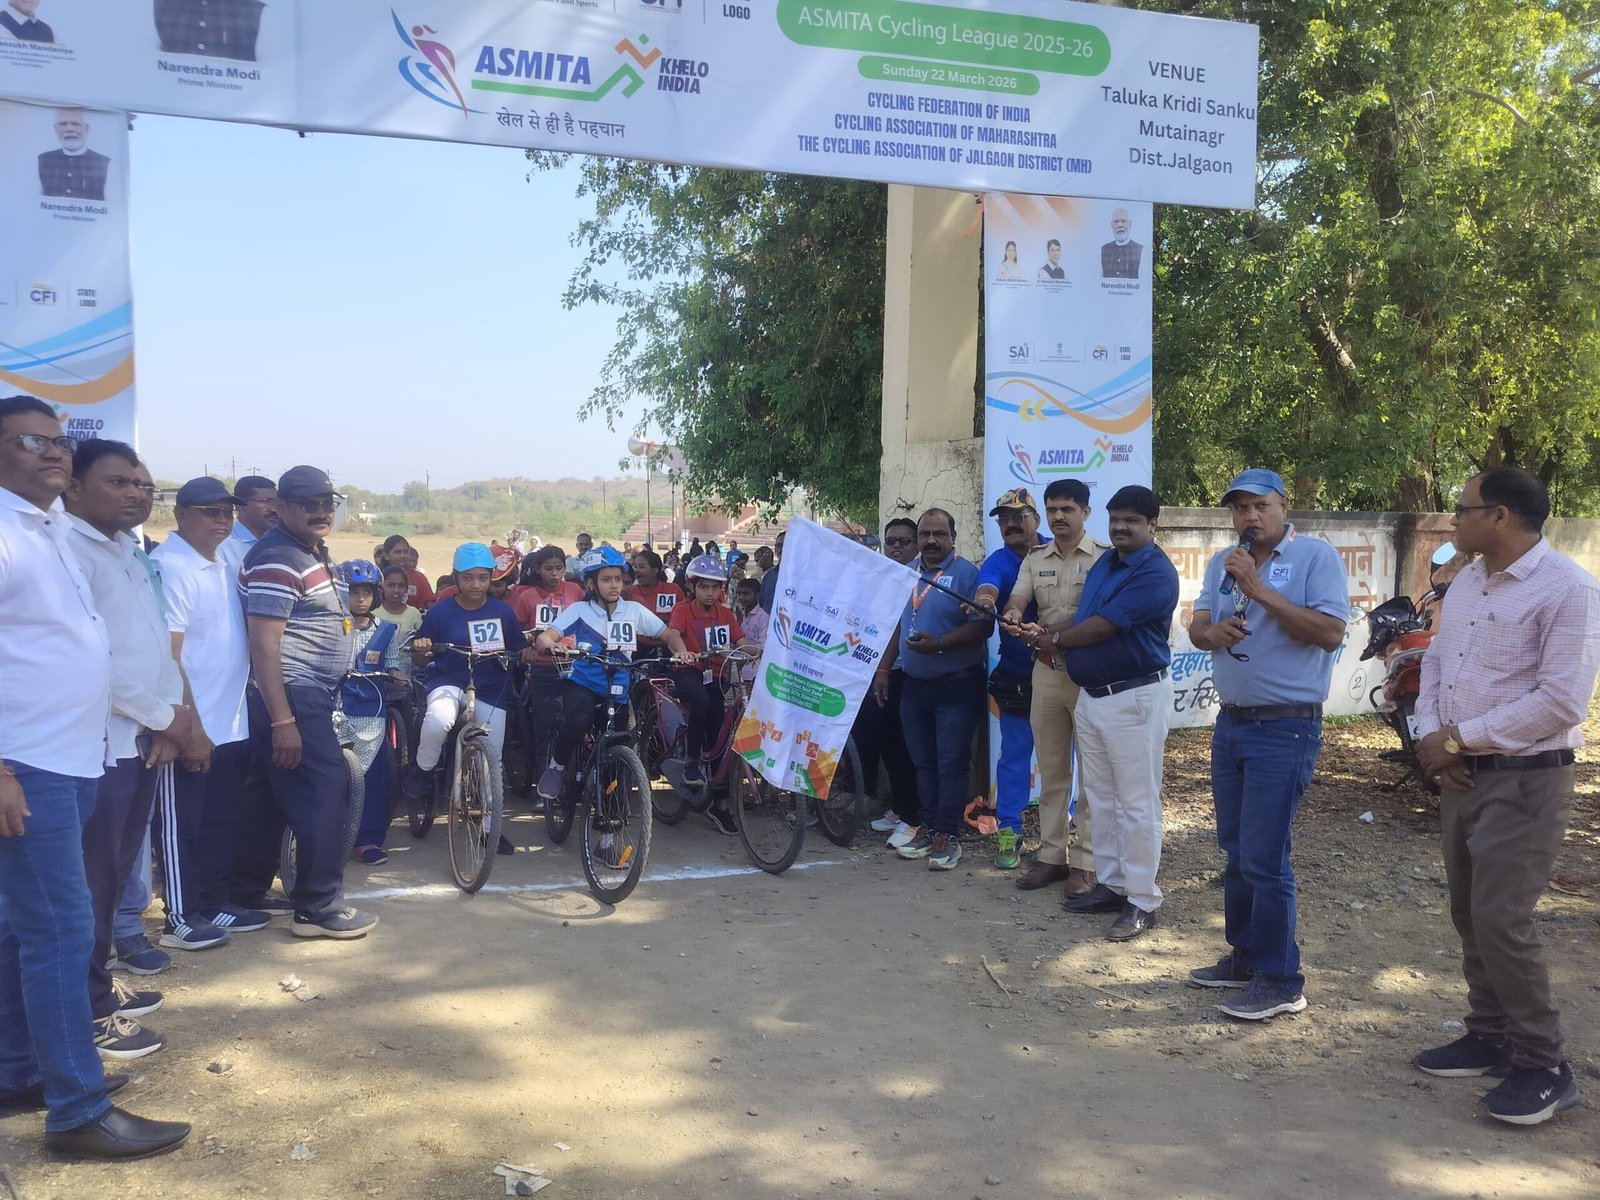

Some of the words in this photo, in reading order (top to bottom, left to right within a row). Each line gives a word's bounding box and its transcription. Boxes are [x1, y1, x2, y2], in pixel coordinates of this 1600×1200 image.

[723, 4, 750, 20] LOGO
[798, 6, 872, 32] ASMITA
[878, 15, 947, 44] Cycling
[952, 23, 1018, 50] League
[1023, 32, 1093, 58] 2025-26
[157, 59, 223, 77] Narendra
[226, 66, 261, 80] Modi
[474, 45, 591, 85] ASMITA
[660, 57, 709, 78] KHELO
[1148, 60, 1206, 83] VENUE
[882, 63, 928, 81] Sunday
[931, 69, 945, 81] 22
[947, 70, 985, 86] March
[988, 75, 1017, 89] 2026
[178, 78, 205, 88] Prime
[206, 80, 243, 91] Minister
[657, 75, 701, 94] INDIA
[867, 92, 914, 112] CYCLING
[918, 97, 982, 118] FEDERATION
[986, 104, 999, 120] OF
[1002, 105, 1030, 123] INDIA
[1101, 85, 1158, 108] Taluka
[1163, 93, 1201, 114] Kridi
[1206, 99, 1255, 121] Sanku
[496, 107, 523, 128] खेल
[528, 109, 540, 129] से
[545, 112, 560, 134] ही
[564, 112, 575, 135] है
[579, 120, 625, 138] पहचान
[834, 113, 882, 132] CYCLING
[885, 118, 957, 140] ASSOCIATION
[960, 125, 974, 140] OF
[977, 127, 1057, 149] MAHARASHTRA
[1139, 119, 1225, 148] Mutainagr
[798, 134, 820, 153] THE
[823, 136, 870, 156] CYCLING
[874, 140, 946, 162] ASSOCIATION
[949, 147, 963, 163] OF
[966, 149, 1014, 168] JALGAON
[1018, 153, 1063, 173] DISTRICT
[1066, 157, 1092, 174] (MH)
[1129, 148, 1232, 175] Dist.Jalgaon
[40, 201, 84, 214] Narendra
[85, 203, 108, 215] Modi
[77, 288, 96, 297] STATE
[1101, 282, 1126, 290] Narendra
[30, 289, 56, 303] CFI
[79, 299, 96, 307] LOGO
[1009, 345, 1029, 358] SAI
[1092, 350, 1108, 359] CFI
[68, 418, 104, 431] KHELO
[1112, 444, 1133, 453] KHELO
[1038, 449, 1084, 465] ASMITA
[1110, 454, 1129, 462] INDIA
[1273, 568, 1289, 576] CFI
[658, 594, 675, 608] 04
[825, 605, 839, 616] SAI
[474, 621, 500, 643] 52
[610, 622, 633, 643] 49
[794, 620, 832, 646] ASMITA
[851, 651, 872, 665] INDIA
[855, 643, 879, 659] KHELO
[1352, 676, 1361, 690] 2
